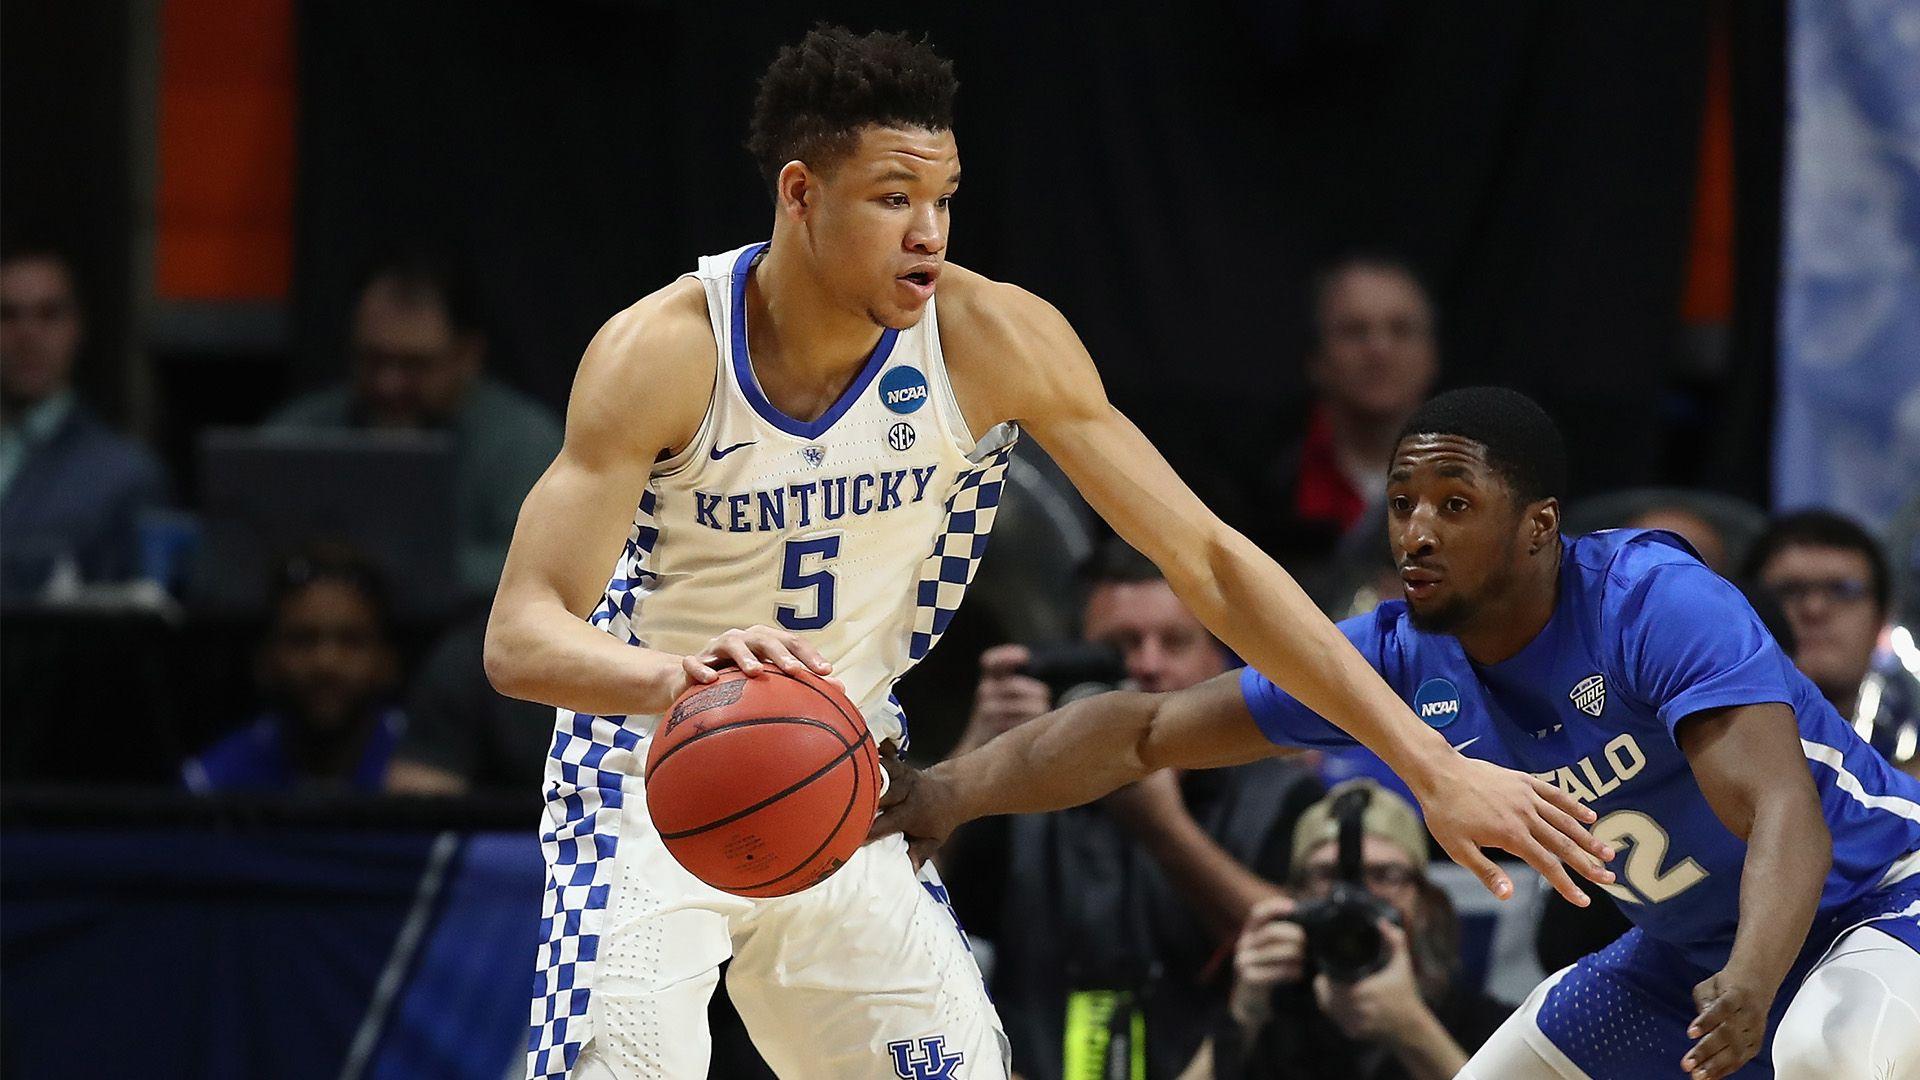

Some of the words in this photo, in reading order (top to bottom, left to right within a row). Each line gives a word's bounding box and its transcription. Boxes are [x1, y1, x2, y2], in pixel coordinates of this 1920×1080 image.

[887, 385, 928, 404] NCAA
[889, 423, 915, 450] SEC
[695, 464, 938, 533] KENTUCKY
[774, 530, 841, 632] 5
[1420, 699, 1459, 717] NCAA
[1573, 681, 1606, 710] MAC
